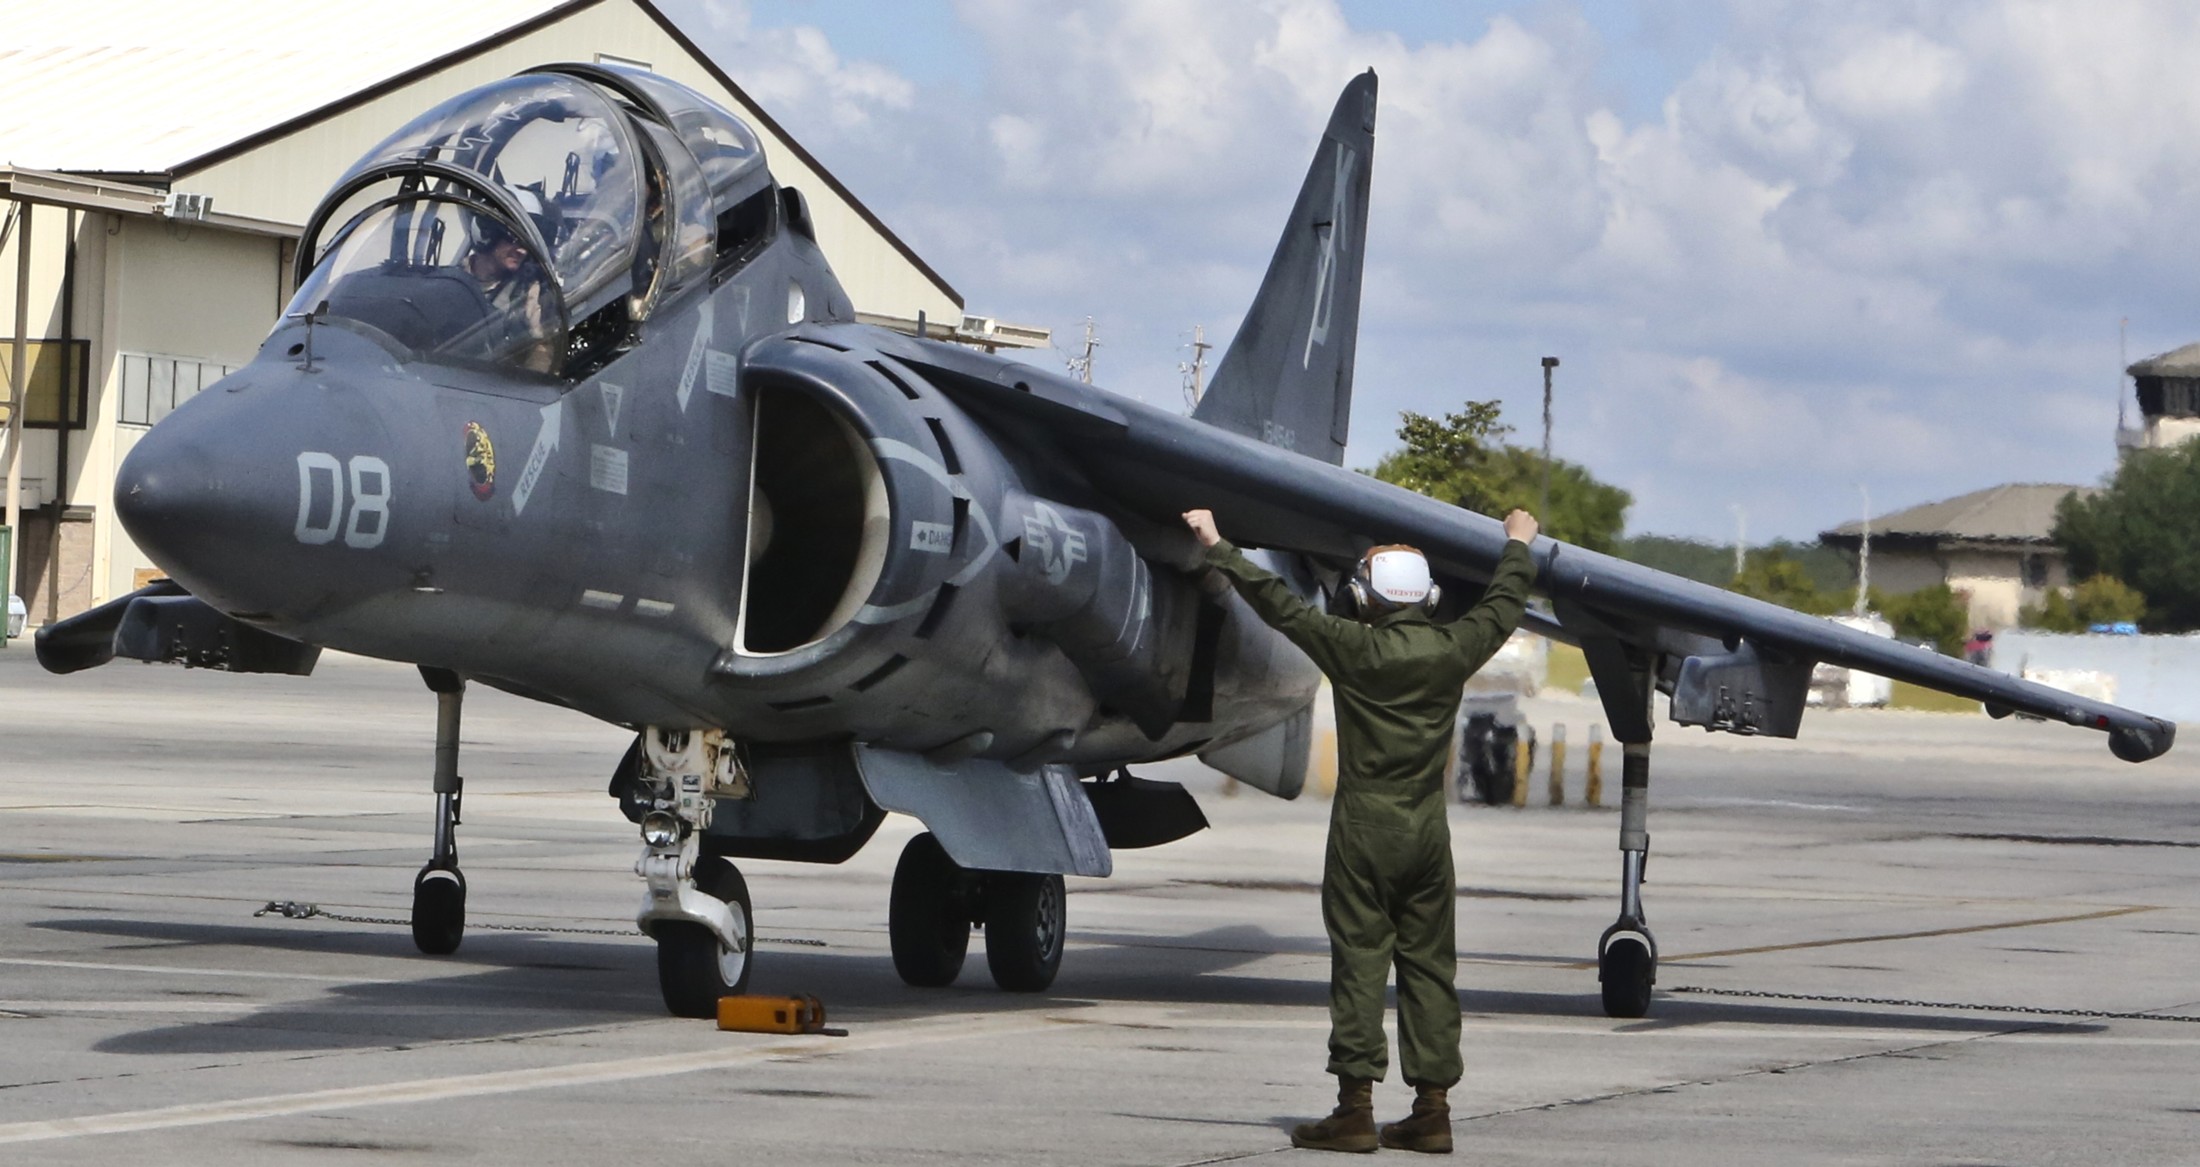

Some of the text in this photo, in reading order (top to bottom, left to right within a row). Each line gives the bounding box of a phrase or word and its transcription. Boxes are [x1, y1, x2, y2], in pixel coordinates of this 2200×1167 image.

[520, 440, 546, 498] RESCUE
[294, 451, 391, 549] 08
[928, 529, 953, 547] DANG
